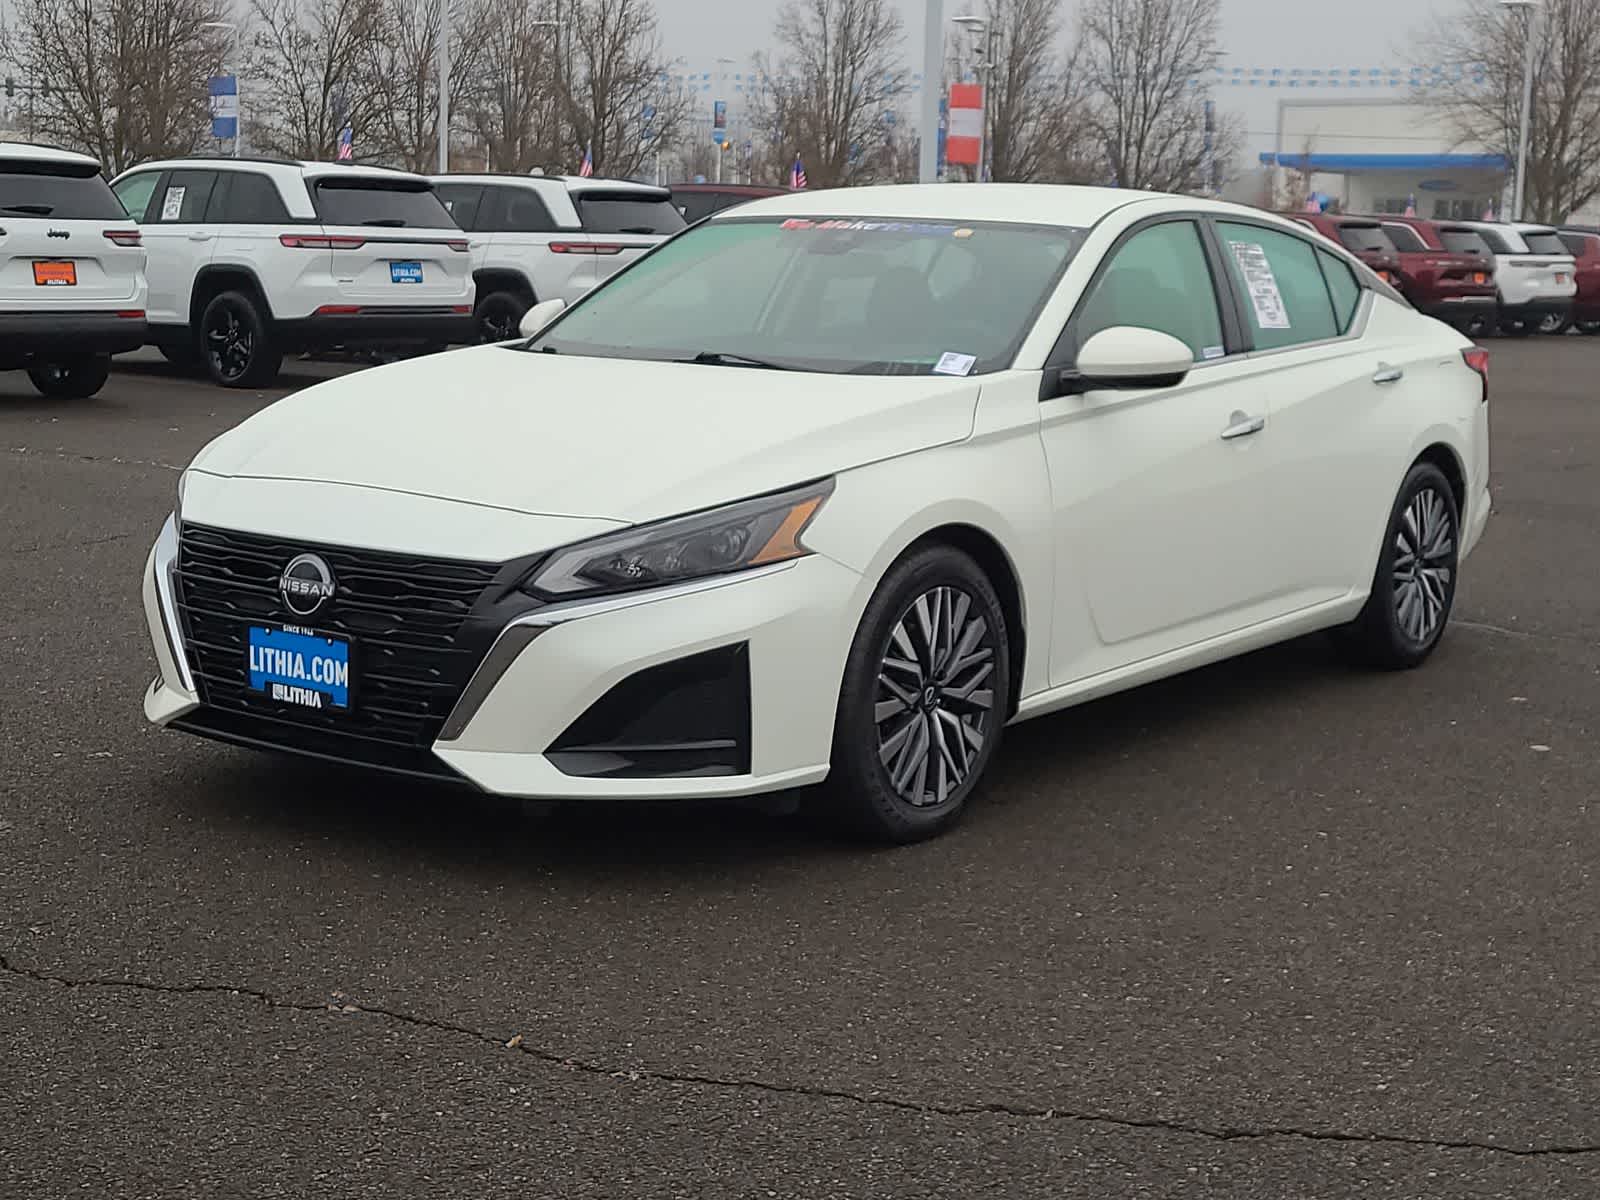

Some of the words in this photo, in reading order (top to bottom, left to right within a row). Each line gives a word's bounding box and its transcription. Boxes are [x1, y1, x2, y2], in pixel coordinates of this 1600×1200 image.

[47, 228, 70, 240] Jeep
[279, 576, 334, 597] NISSAN
[249, 645, 349, 688] LITHIA.COM
[283, 685, 322, 709] LITHIA
